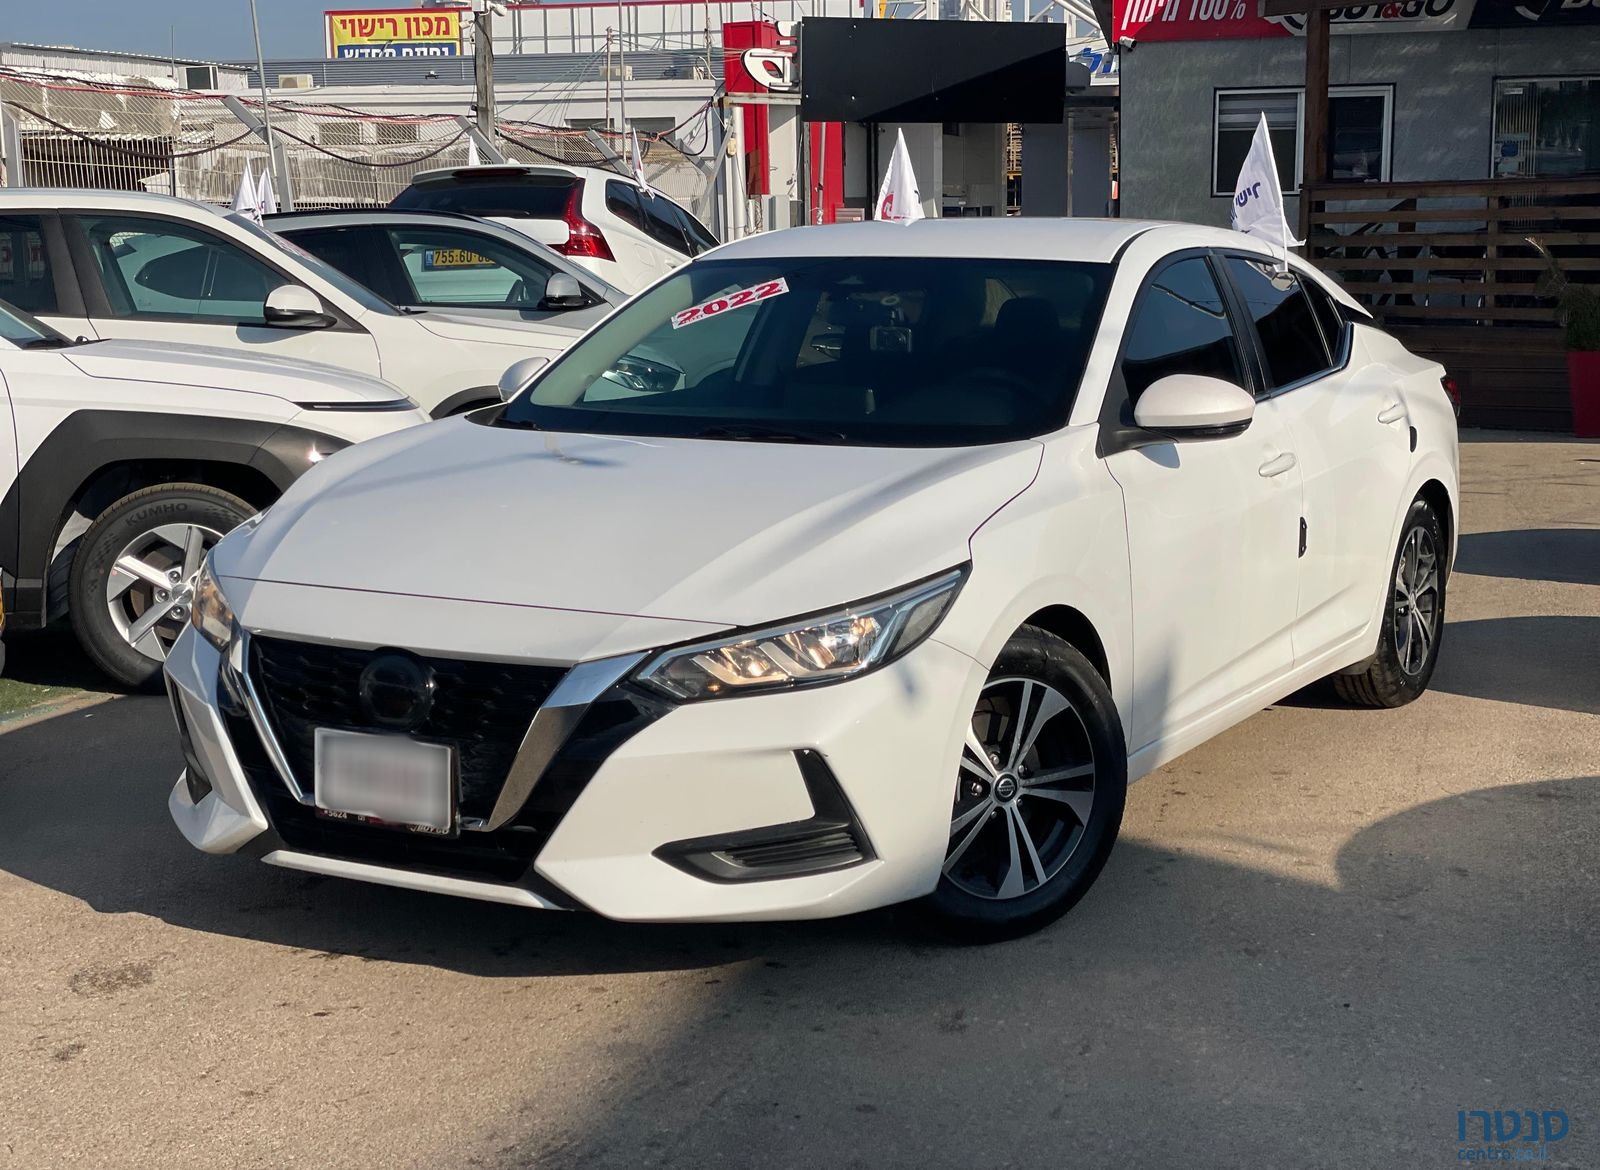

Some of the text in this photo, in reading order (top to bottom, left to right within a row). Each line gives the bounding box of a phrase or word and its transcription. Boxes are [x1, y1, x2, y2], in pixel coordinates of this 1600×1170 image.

[340, 16, 450, 39] מכון רישוי
[677, 282, 783, 326] 2022
[126, 502, 188, 526] KUMHO
